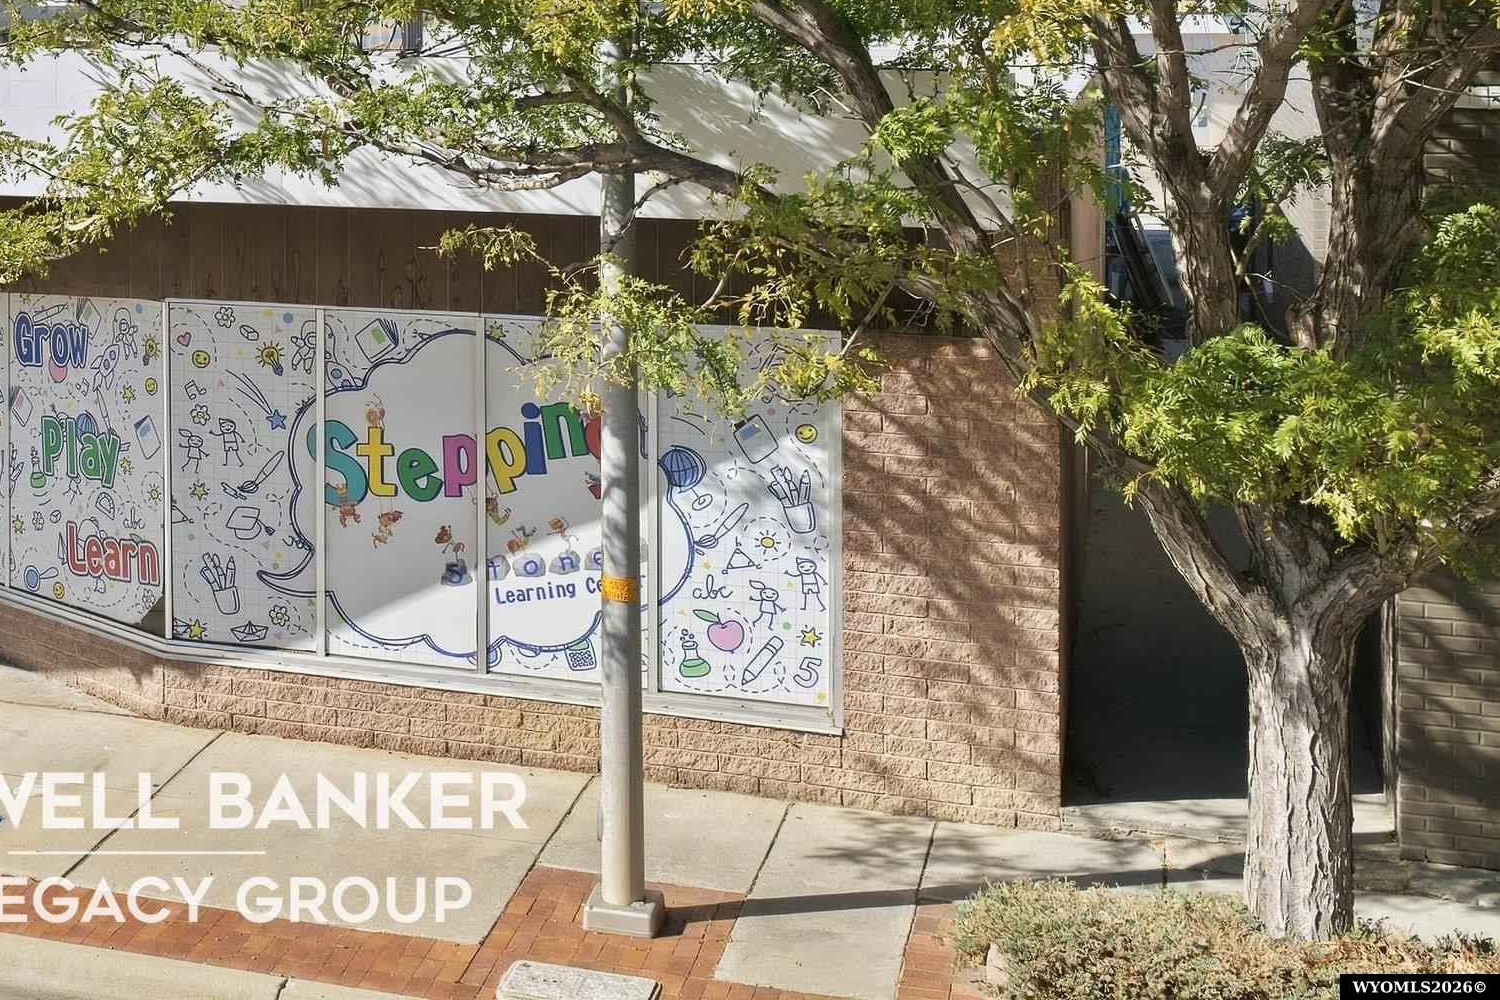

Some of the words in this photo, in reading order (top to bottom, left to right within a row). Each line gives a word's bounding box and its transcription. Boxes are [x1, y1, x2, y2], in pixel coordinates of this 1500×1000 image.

[14, 312, 90, 369] Grow
[41, 415, 121, 489] Play
[66, 520, 160, 587] Learn
[496, 581, 576, 605] Learning
[692, 574, 733, 600] abc
[793, 656, 823, 689] 5
